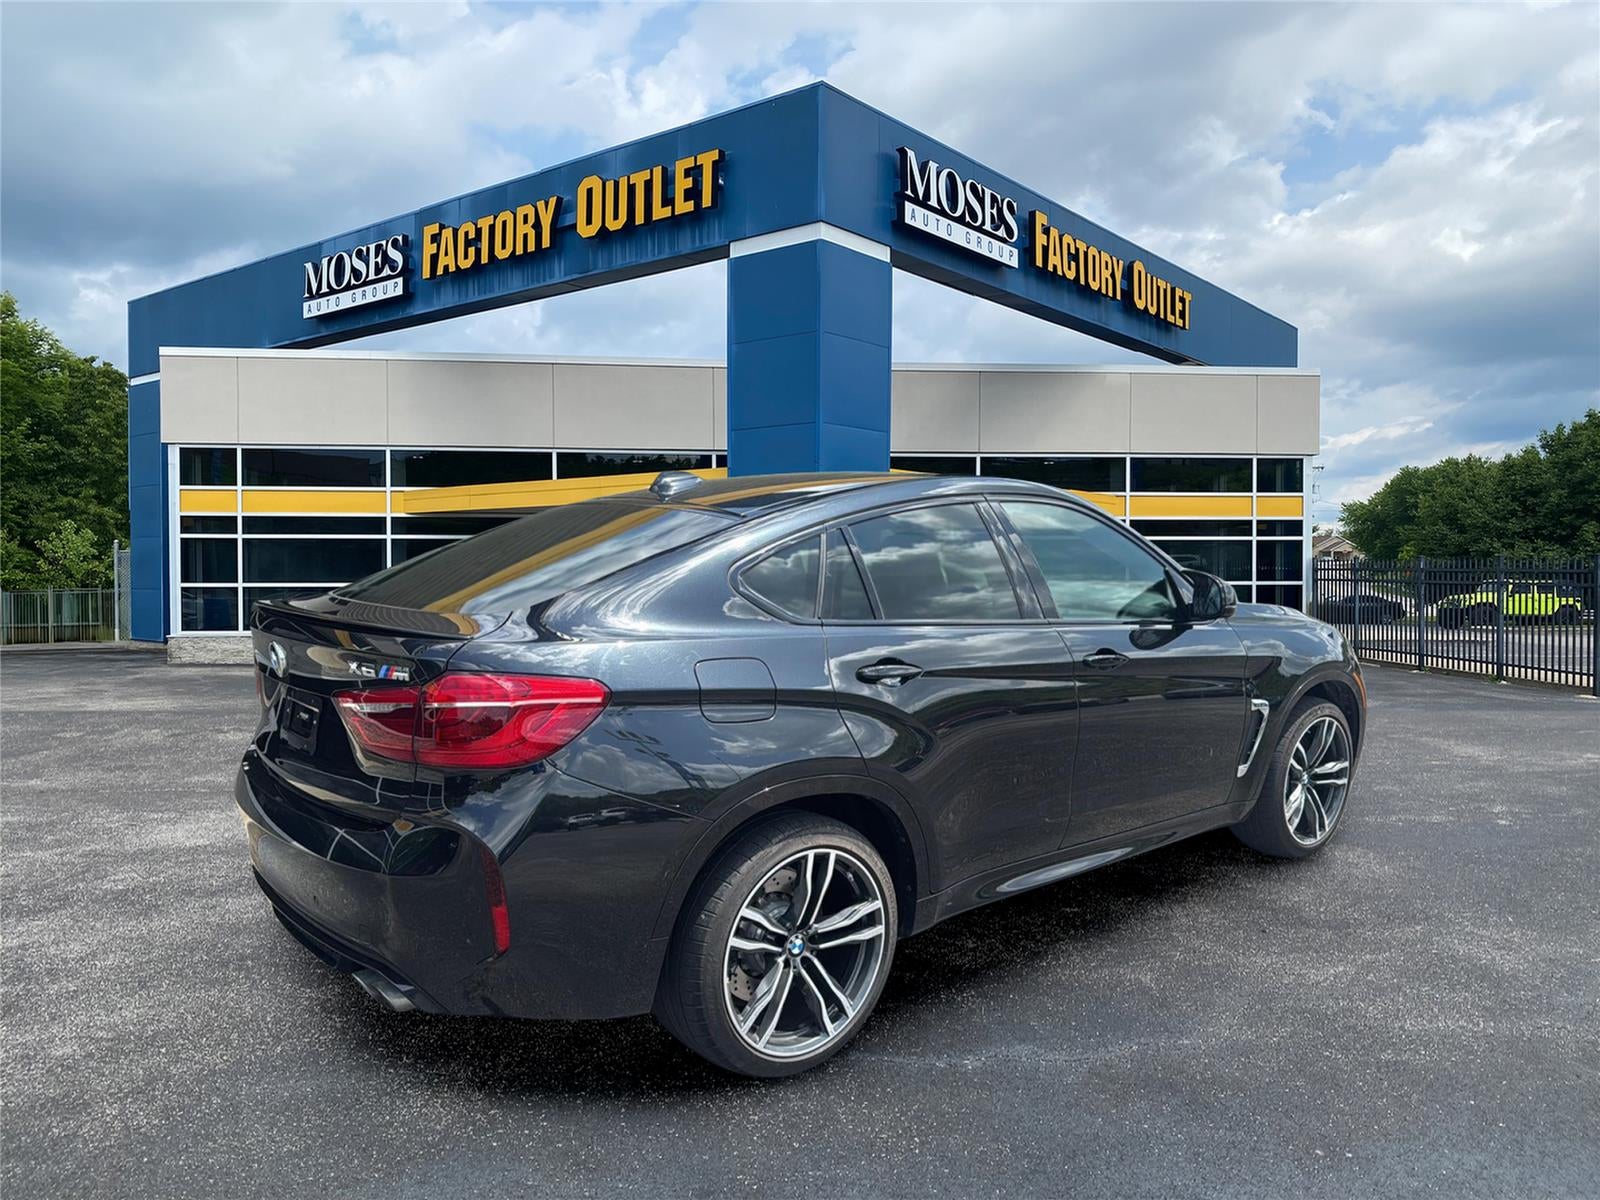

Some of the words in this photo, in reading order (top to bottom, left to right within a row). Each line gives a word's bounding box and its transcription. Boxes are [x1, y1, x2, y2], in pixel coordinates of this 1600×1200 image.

[422, 196, 558, 279] FACTORY
[577, 149, 719, 239] OUTLET
[904, 147, 1018, 243] MOSES
[910, 208, 953, 237] AUTO
[965, 231, 1014, 261] GROUP
[303, 234, 404, 298] MOSES
[307, 296, 340, 315] AUTO
[351, 281, 399, 304] GROUP
[1035, 210, 1124, 300] FACTORY
[1133, 260, 1192, 330] OUTLET
